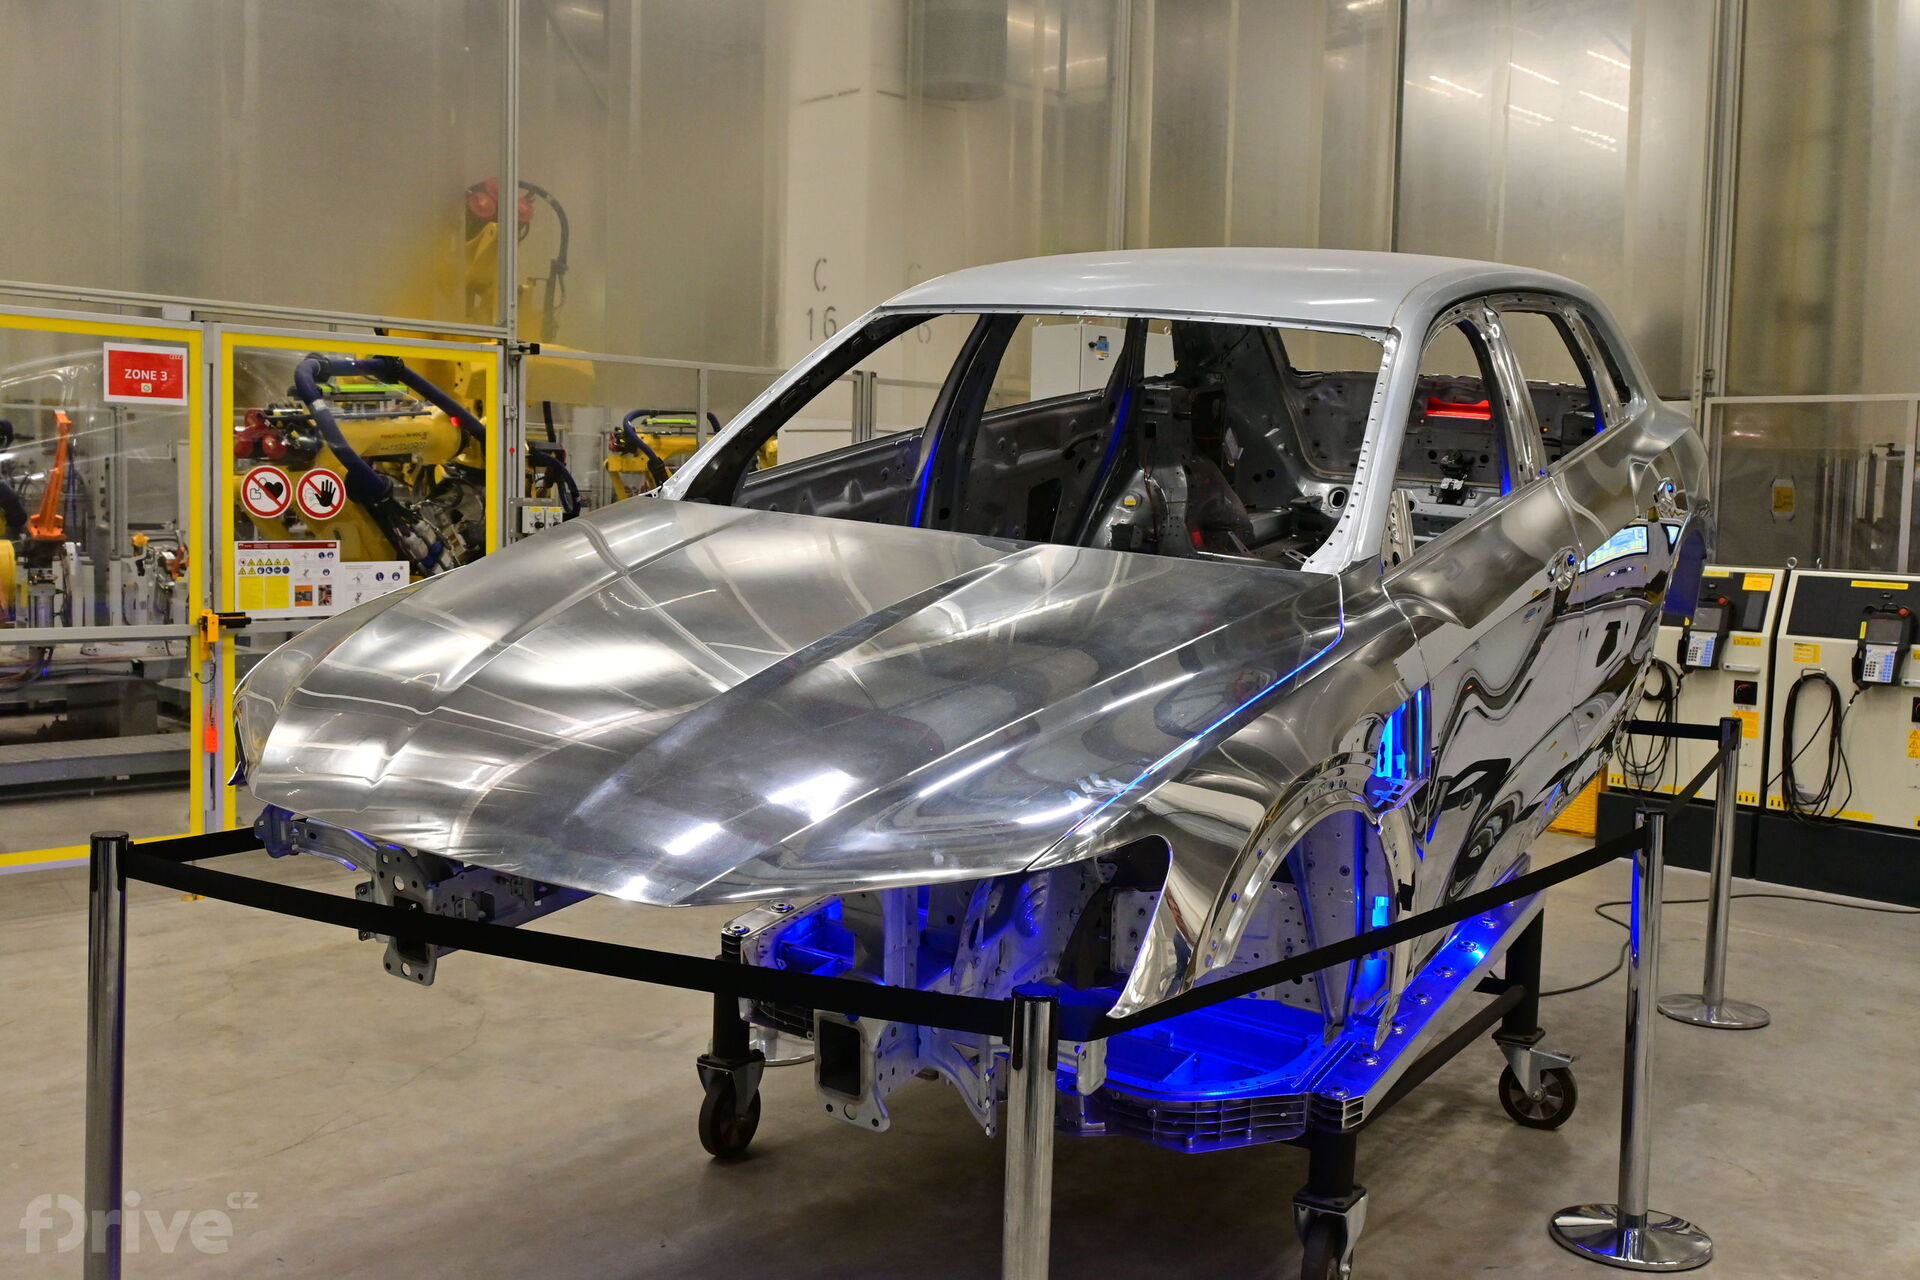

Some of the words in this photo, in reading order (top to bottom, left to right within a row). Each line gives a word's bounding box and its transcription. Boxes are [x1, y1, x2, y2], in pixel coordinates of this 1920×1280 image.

[813, 257, 828, 293] C
[806, 305, 837, 341] 16
[124, 368, 157, 380] ZONE
[160, 370, 168, 382] 3
